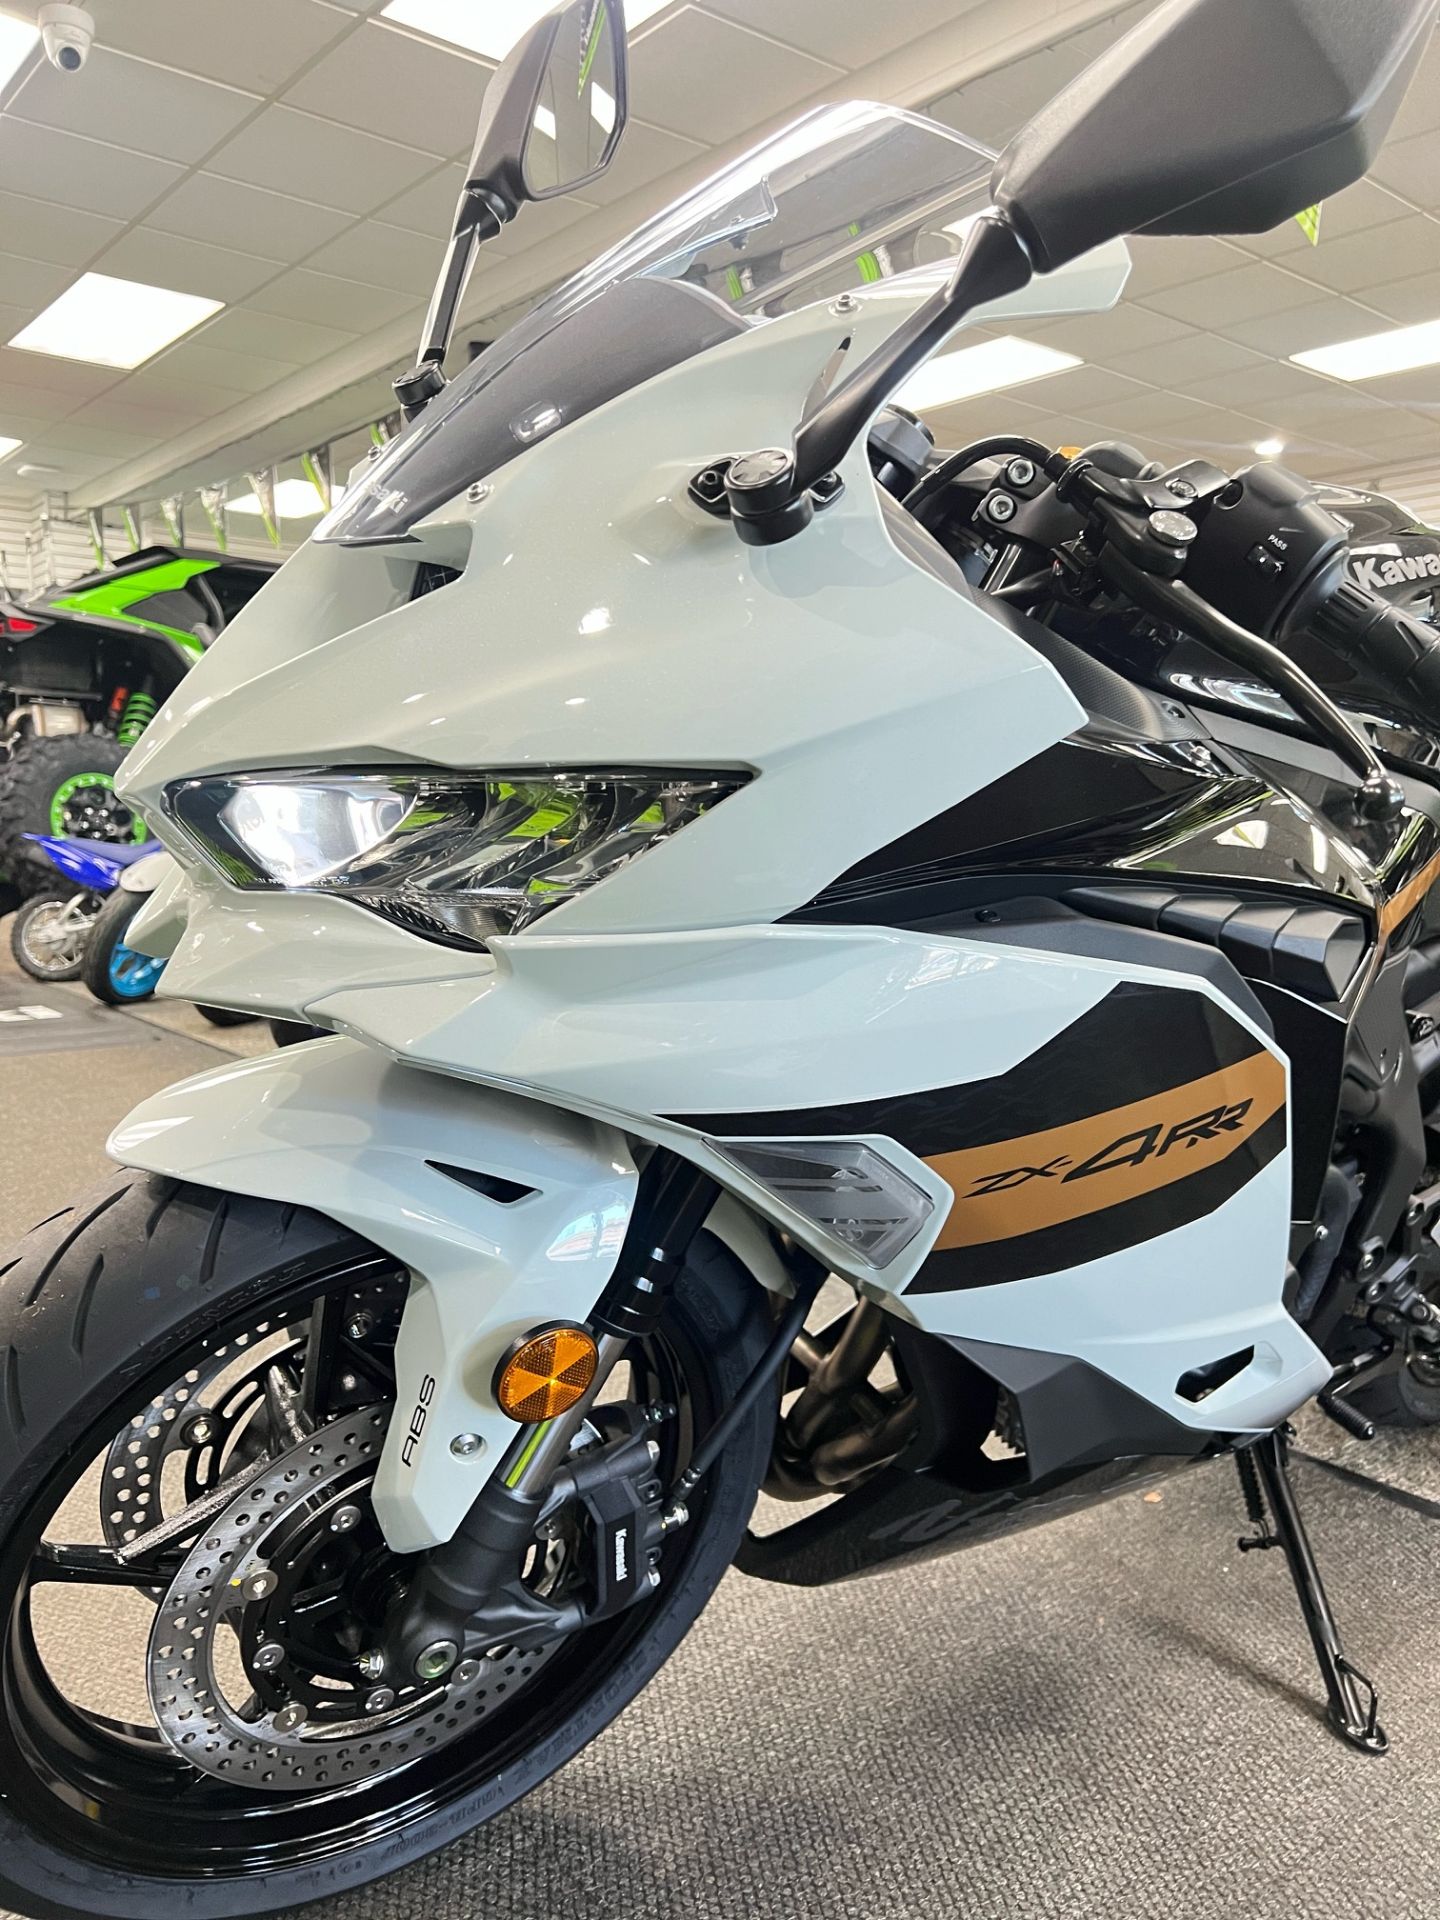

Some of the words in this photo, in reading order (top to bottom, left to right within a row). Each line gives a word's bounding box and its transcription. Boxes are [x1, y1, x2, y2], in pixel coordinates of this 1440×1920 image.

[1267, 534, 1288, 551] PASS
[1352, 553, 1440, 590] Kawa
[961, 1097, 1254, 1199] ZX-4RR
[401, 1374, 436, 1468] ABS
